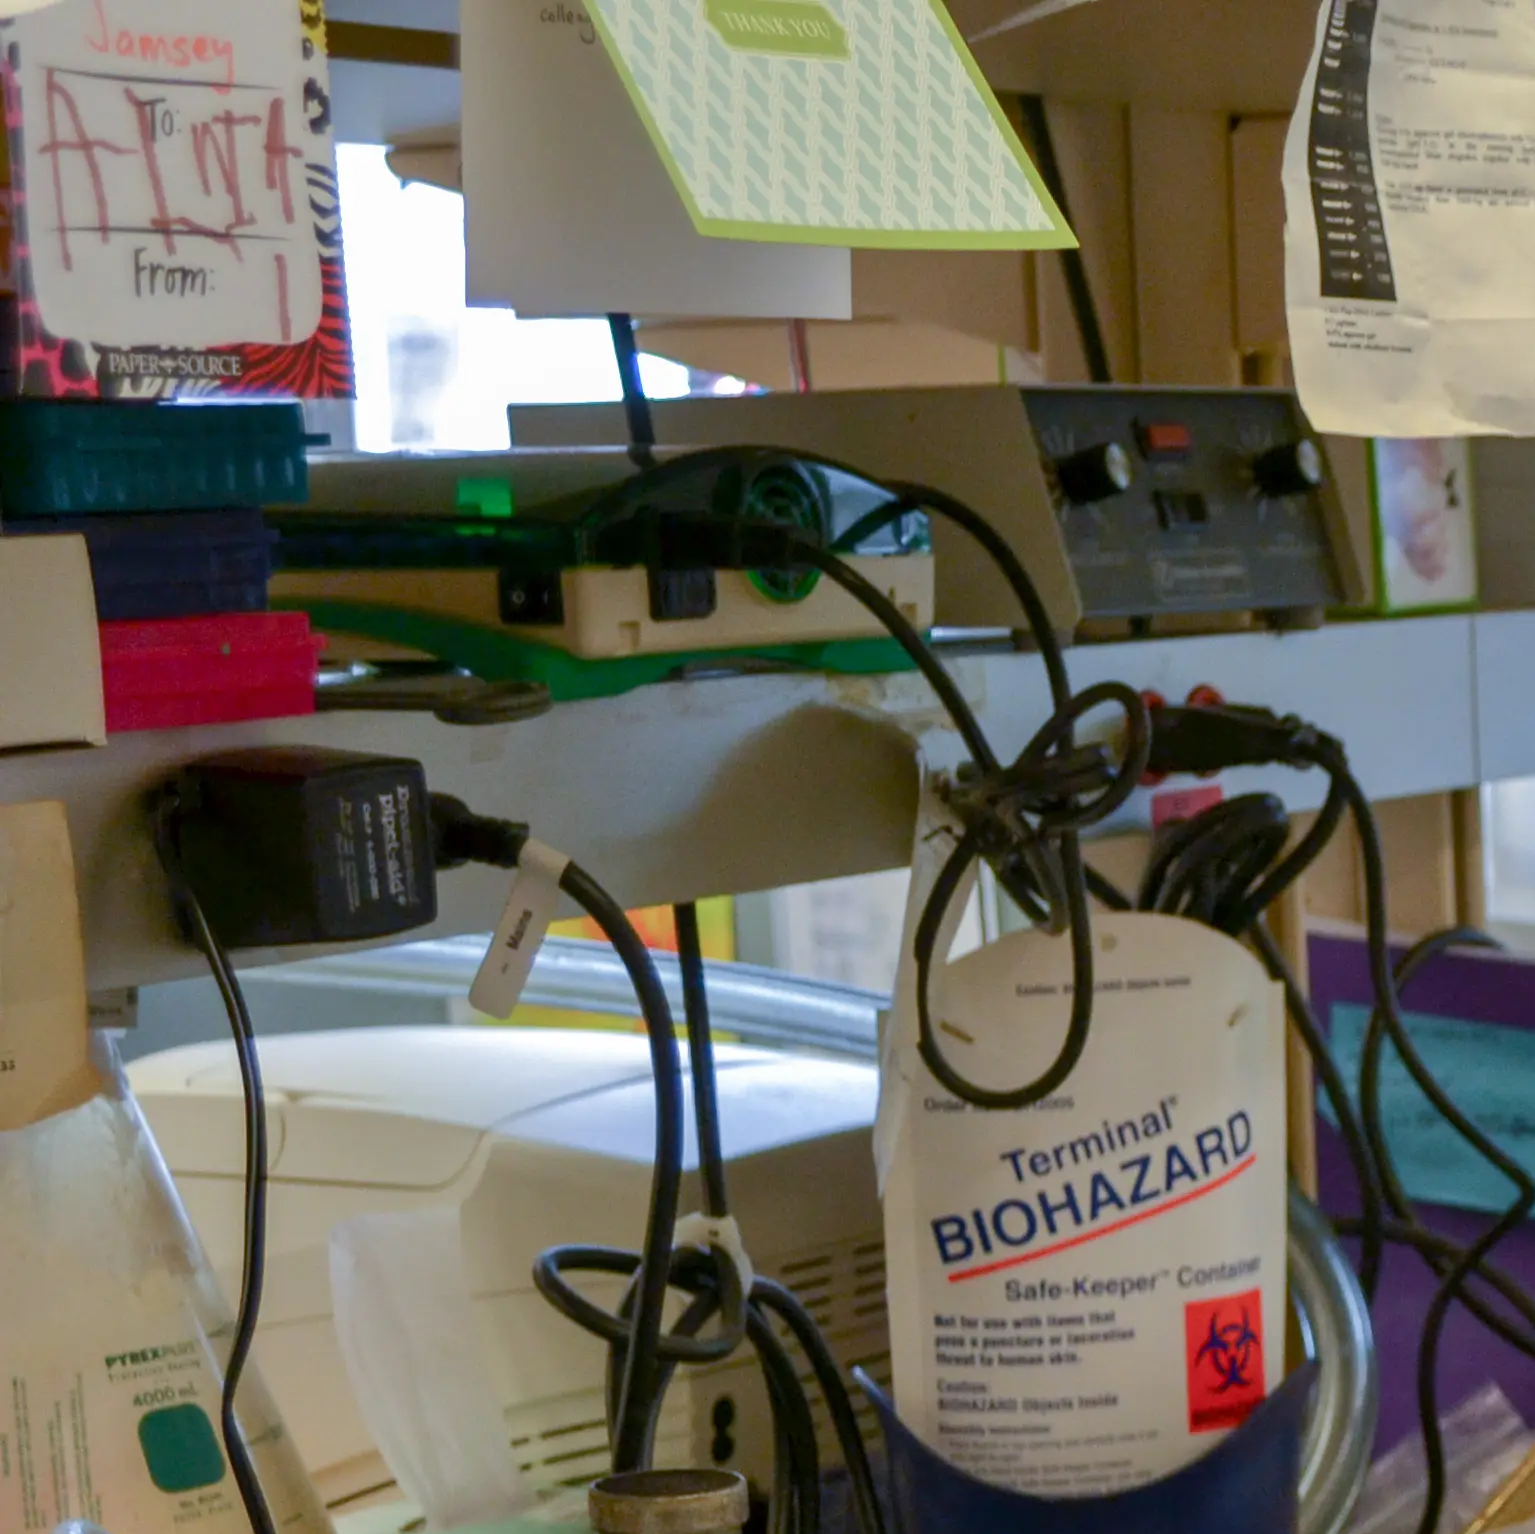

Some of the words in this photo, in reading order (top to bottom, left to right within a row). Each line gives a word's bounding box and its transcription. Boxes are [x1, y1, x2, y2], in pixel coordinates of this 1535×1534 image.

[721, 11, 787, 36] THANK
[788, 19, 831, 39] YOU
[134, 247, 215, 298] From:
[109, 352, 160, 375] PAPER
[178, 353, 242, 377] SOURCE
[505, 908, 533, 951] Mains
[931, 1110, 1253, 1265] BIOHAZARD
[133, 1386, 175, 1408] 4000
